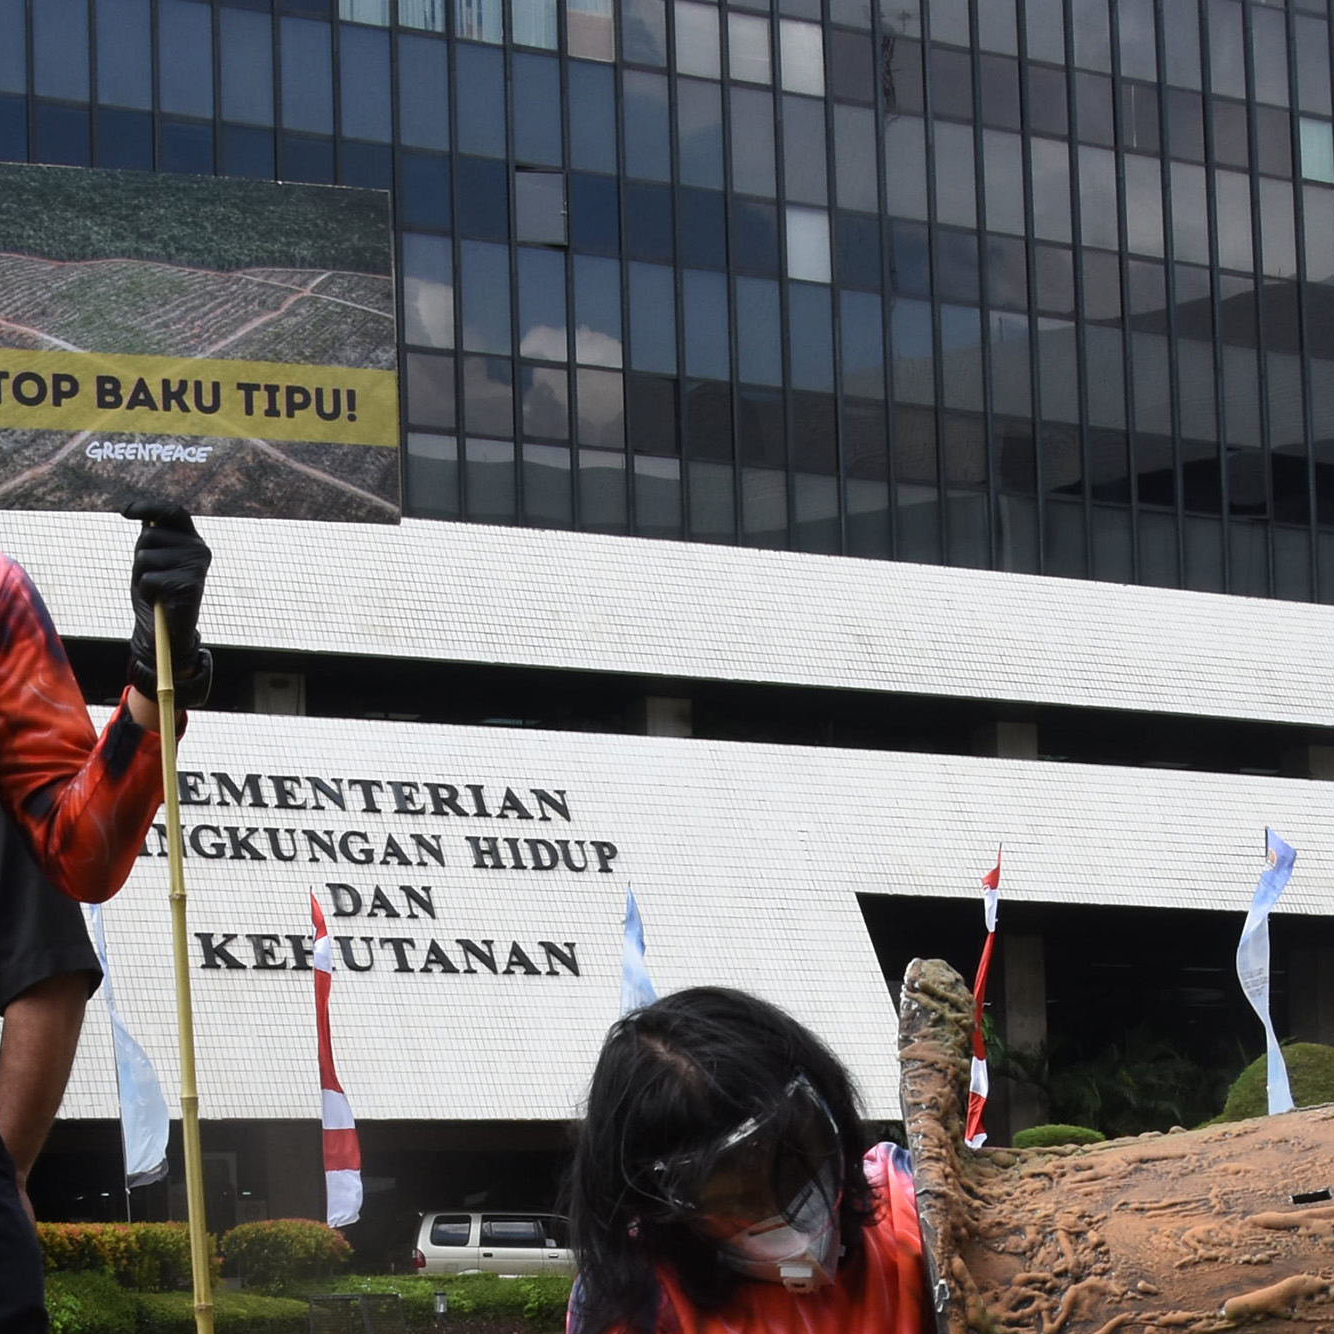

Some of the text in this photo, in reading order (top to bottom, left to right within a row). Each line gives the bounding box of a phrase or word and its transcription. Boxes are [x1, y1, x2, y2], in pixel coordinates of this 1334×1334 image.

[95, 375, 221, 414] BAKU
[236, 382, 358, 422] TIPU!
[85, 440, 213, 464] GREENPEACE
[177, 770, 572, 823] EMENTERIAN
[136, 823, 619, 874] NGKUNGAN HIDUP
[325, 883, 437, 920] DAN
